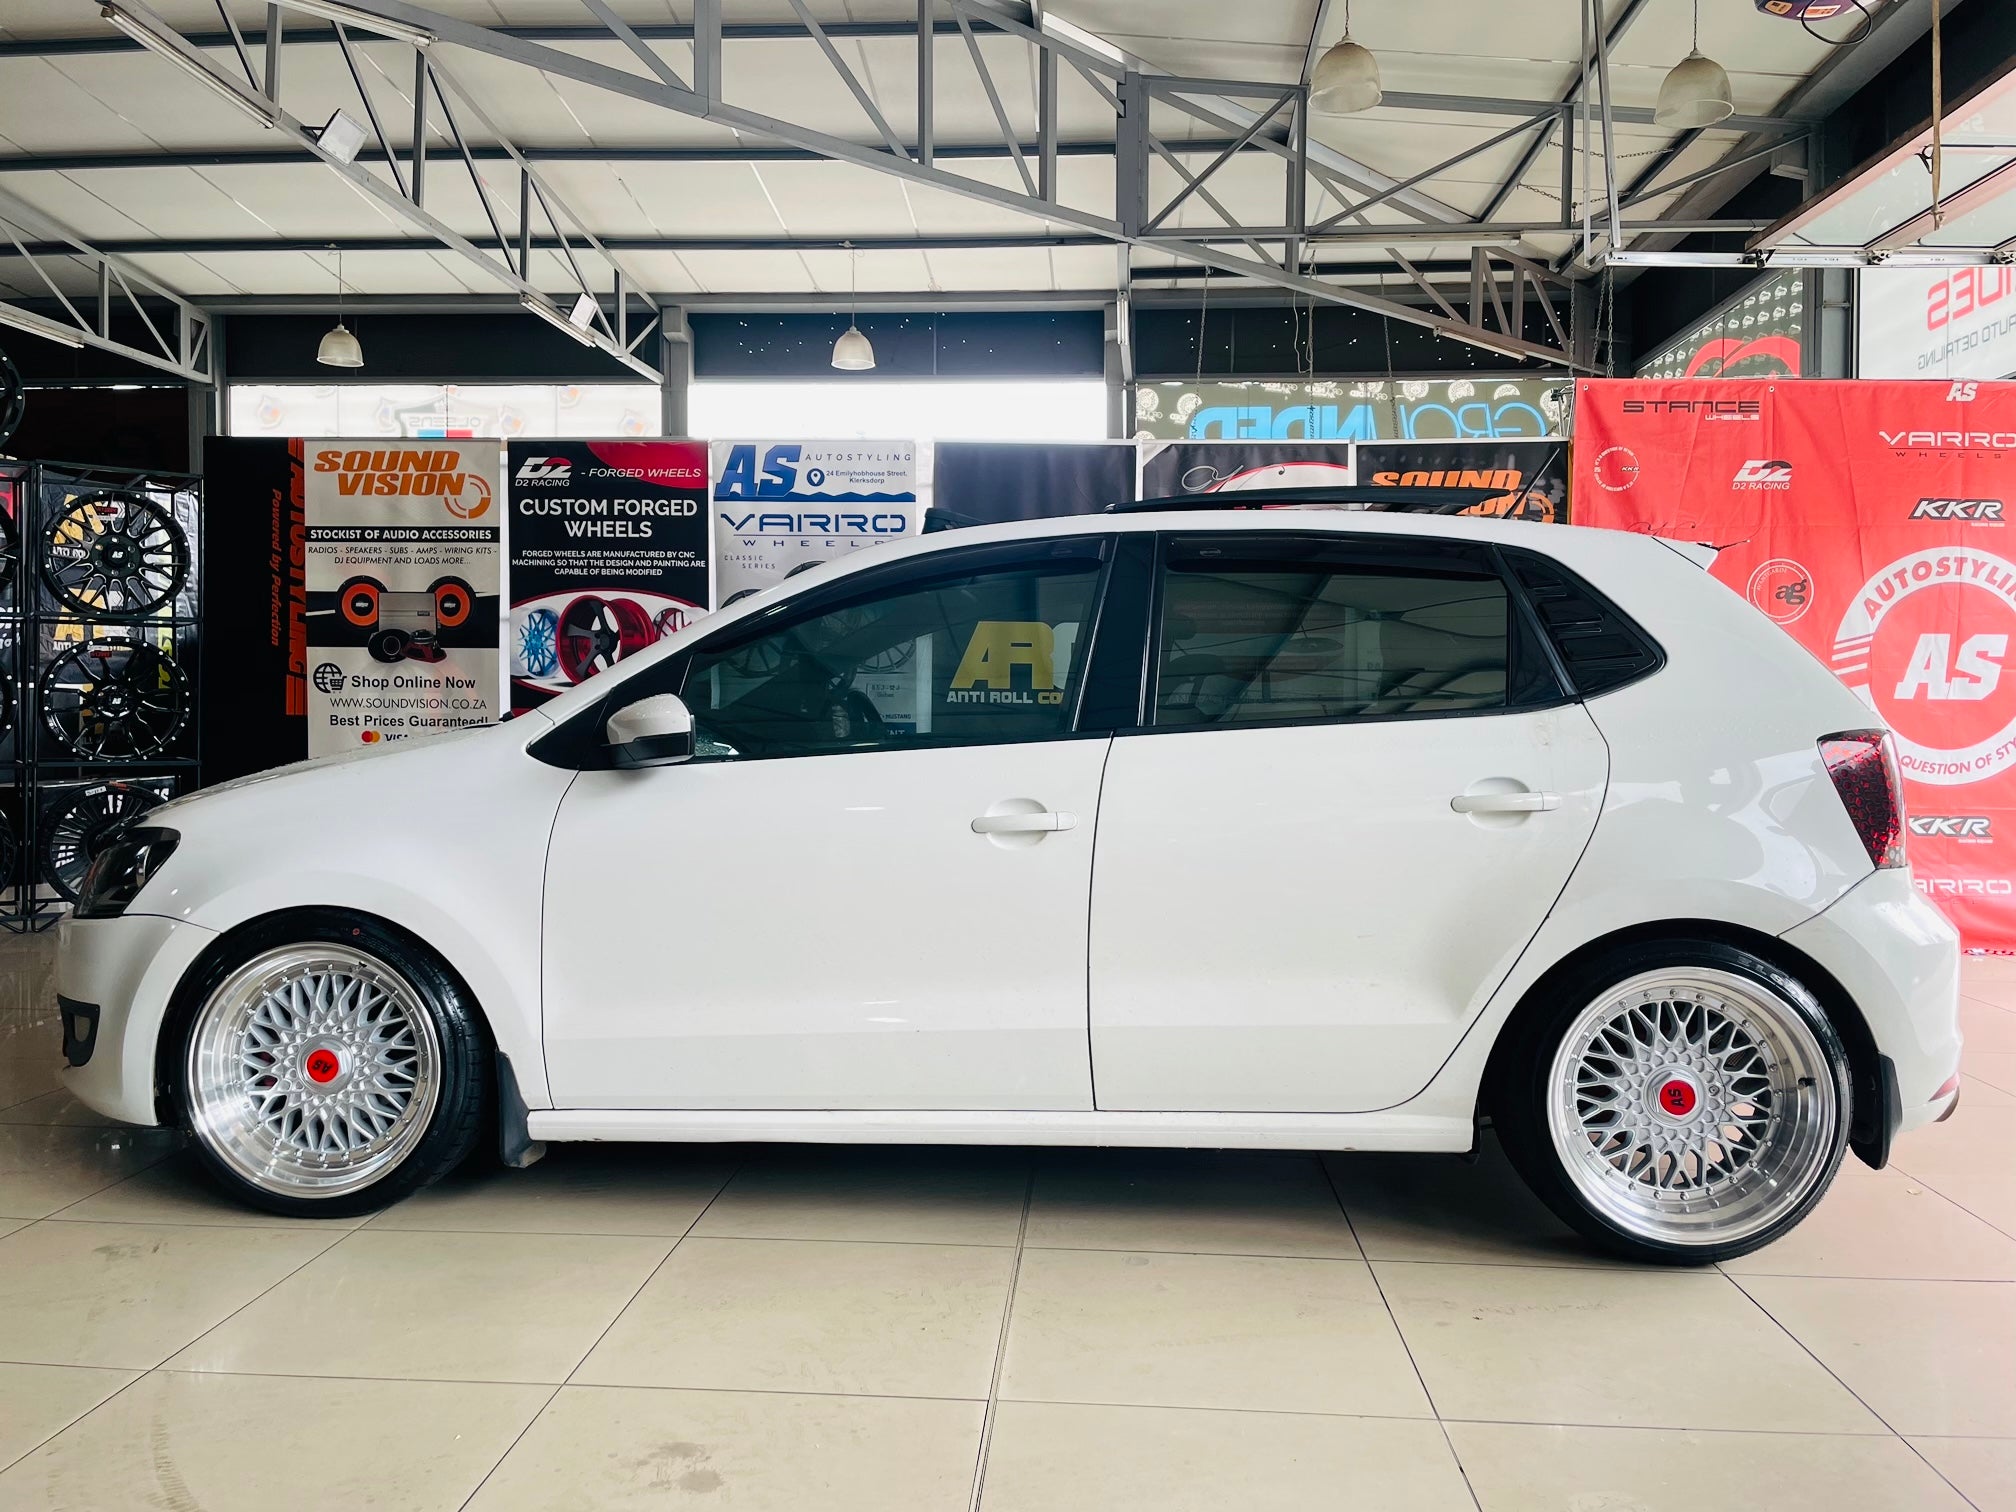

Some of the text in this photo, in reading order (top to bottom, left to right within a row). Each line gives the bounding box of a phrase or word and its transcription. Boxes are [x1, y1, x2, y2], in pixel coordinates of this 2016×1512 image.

[1946, 382, 1979, 402] AS
[1623, 401, 1760, 413] STANCE
[313, 450, 461, 472] SOUND
[805, 453, 912, 462] AUTOSTYLING
[588, 468, 702, 478] FORGED WHEELS
[714, 444, 802, 497] AS
[835, 470, 886, 478] Emilyhobhouse
[337, 473, 466, 496] VISION
[515, 479, 570, 487] D2 RACING
[1372, 469, 1523, 491] SOUND
[1732, 482, 1791, 490] D2 RACING
[519, 498, 698, 516] CUSTOM FORGED
[1910, 499, 2004, 520] KKR
[310, 529, 492, 540] STOCKIST OF AUDIO ACCESSORIES
[564, 520, 653, 538] WHEELS
[308, 546, 342, 554] RADIOS
[345, 546, 383, 554] SPEAKERS
[415, 547, 438, 555] AMPS
[444, 547, 473, 555] WIRING
[476, 547, 492, 555] KITS
[553, 550, 586, 558] WHEELS
[678, 551, 696, 559] CNC
[270, 488, 282, 646] Powered by Perfection
[393, 557, 412, 565] AND
[414, 557, 440, 565] LOADS
[589, 559, 605, 567] THE
[606, 559, 634, 567] DESIGN
[690, 560, 706, 568] ARE
[601, 568, 625, 576] BEING
[1893, 633, 2009, 700] AS
[351, 675, 476, 690] Shop Online Now
[329, 698, 487, 710] WWW.SOUNDVISION.CO.ZA
[946, 691, 985, 703] ANTI
[989, 691, 1034, 704] ROLL
[329, 714, 360, 726] Best
[364, 714, 405, 726] Prices
[1901, 755, 1971, 775] QUESTION
[1974, 753, 1992, 770] OF
[1909, 816, 1991, 836] KKR
[1667, 1088, 1686, 1107] AS
